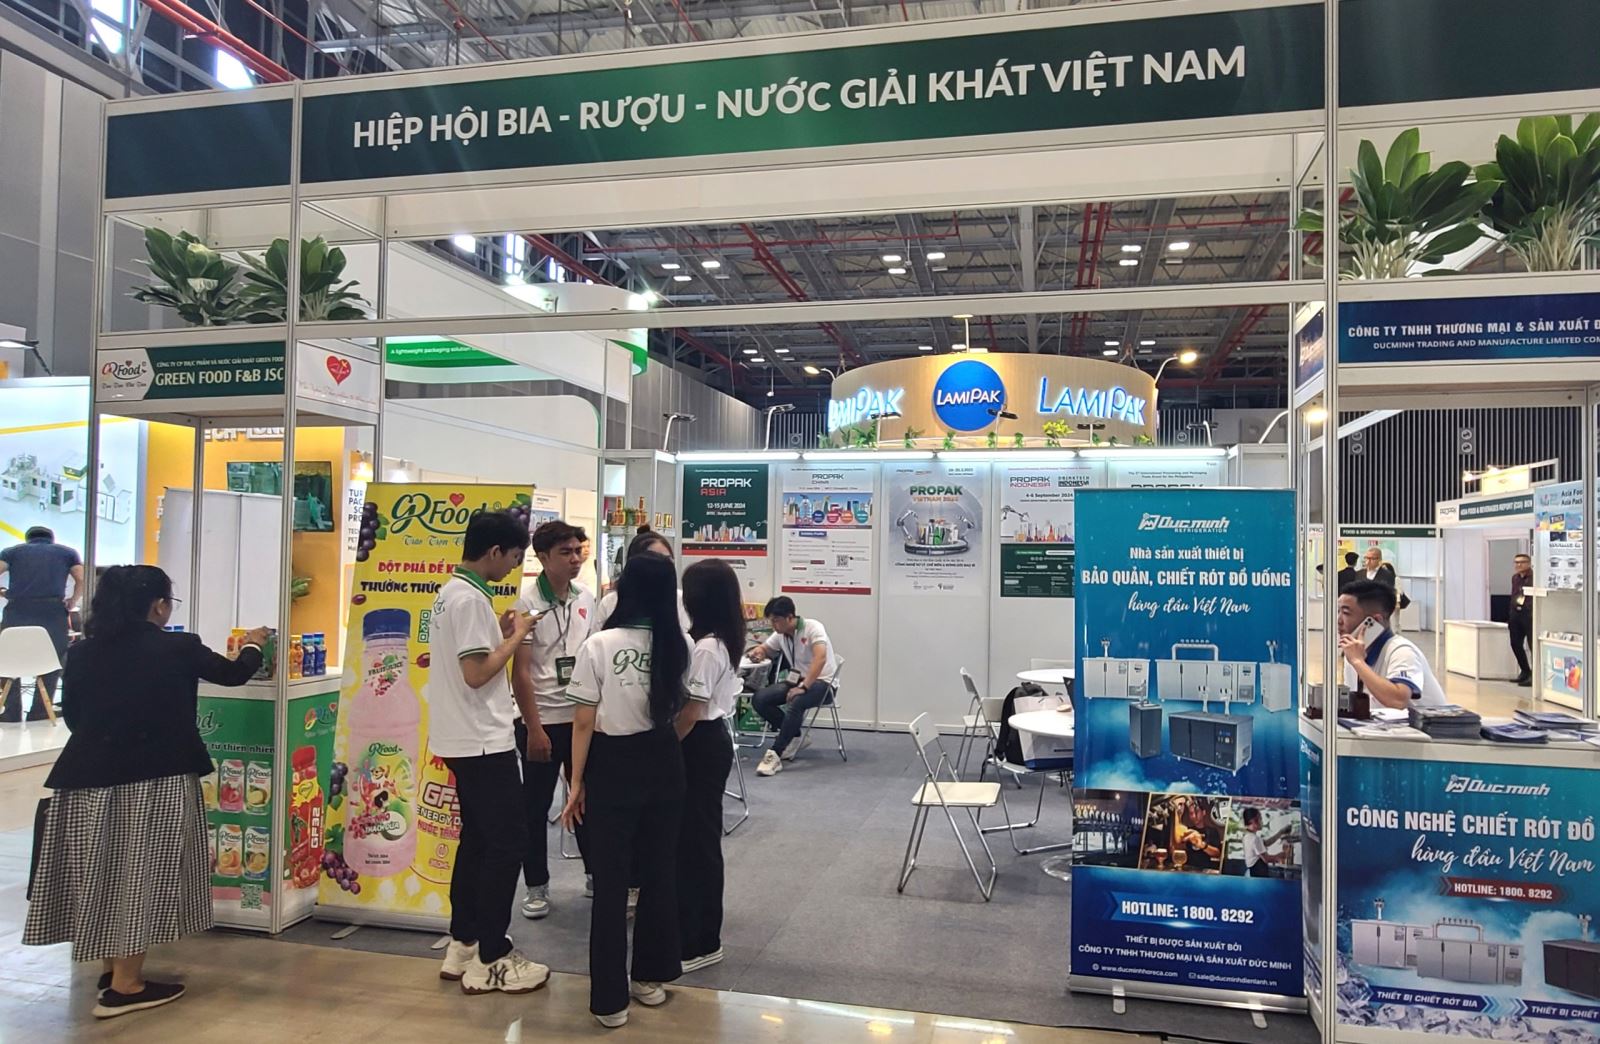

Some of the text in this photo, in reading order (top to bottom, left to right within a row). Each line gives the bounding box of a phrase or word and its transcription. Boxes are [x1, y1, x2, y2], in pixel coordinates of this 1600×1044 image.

[354, 113, 423, 151] HIỆP
[430, 106, 488, 146] HỘI
[498, 106, 552, 137] BIA
[580, 93, 685, 132] RƯỢU
[717, 77, 831, 120] NƯỚC
[840, 68, 917, 109] GIẢI
[929, 58, 1035, 102] KHÁT
[1042, 50, 1133, 96] VIỆT
[1144, 45, 1246, 85] NAM
[1348, 324, 1379, 337] CÔNG
[1384, 325, 1397, 336] TY
[1400, 324, 1432, 335] TNHH
[1436, 322, 1483, 335] THƯƠNG
[1487, 322, 1510, 336] MẠI
[1515, 321, 1524, 332] &
[1528, 317, 1554, 332] SẢN
[1558, 315, 1590, 331] XUẤT
[1373, 336, 1581, 350] DUCMINH TRADING AND MANUFACTURE LIMITED
[155, 371, 196, 386] GREEN
[199, 370, 232, 384] FOOD
[235, 369, 261, 382] F&B
[264, 367, 285, 381] JSC
[936, 388, 1001, 406] LAMIPAK
[700, 478, 752, 488] PROPAK
[700, 488, 727, 496] ASIA
[910, 486, 963, 496] PROPAK
[1130, 544, 1244, 563] Nhà sản xuất thiết bị
[403, 560, 425, 573] PHÁ
[1082, 564, 1109, 584] BẢO
[1112, 564, 1153, 587] QUẢN,
[1157, 565, 1196, 586] CHIẾT
[1200, 568, 1225, 586] RÓT
[1228, 566, 1248, 586] ĐỒ
[1251, 566, 1291, 587] UỐNG
[1128, 590, 1160, 618] hàng
[1193, 596, 1217, 617] Việt
[1219, 597, 1250, 614] Nam
[1346, 804, 1595, 841] CÔNG NGHỆ CHIẾT RÓT ĐỒ
[1411, 834, 1458, 873] hàng
[1508, 847, 1545, 874] Việt
[1549, 849, 1596, 877] Nam
[1454, 882, 1553, 899] HOTLINE: 1800. 8292
[1121, 900, 1254, 924] HOTLINE: 1800. 8292
[1125, 934, 1243, 952] THIẾT BỊ ĐƯỢC SẢN XUẤT BỞI
[1078, 944, 1292, 971] CÔNG TY TNHH THƯƠNG MẠI VÀ SẢN XUẤT ĐỨC MINH
[1376, 990, 1478, 1007] THIẾT BỊ CHIẾT RÓT BIA
[1531, 1004, 1599, 1018] THIẾT BỊ CHIẾT
